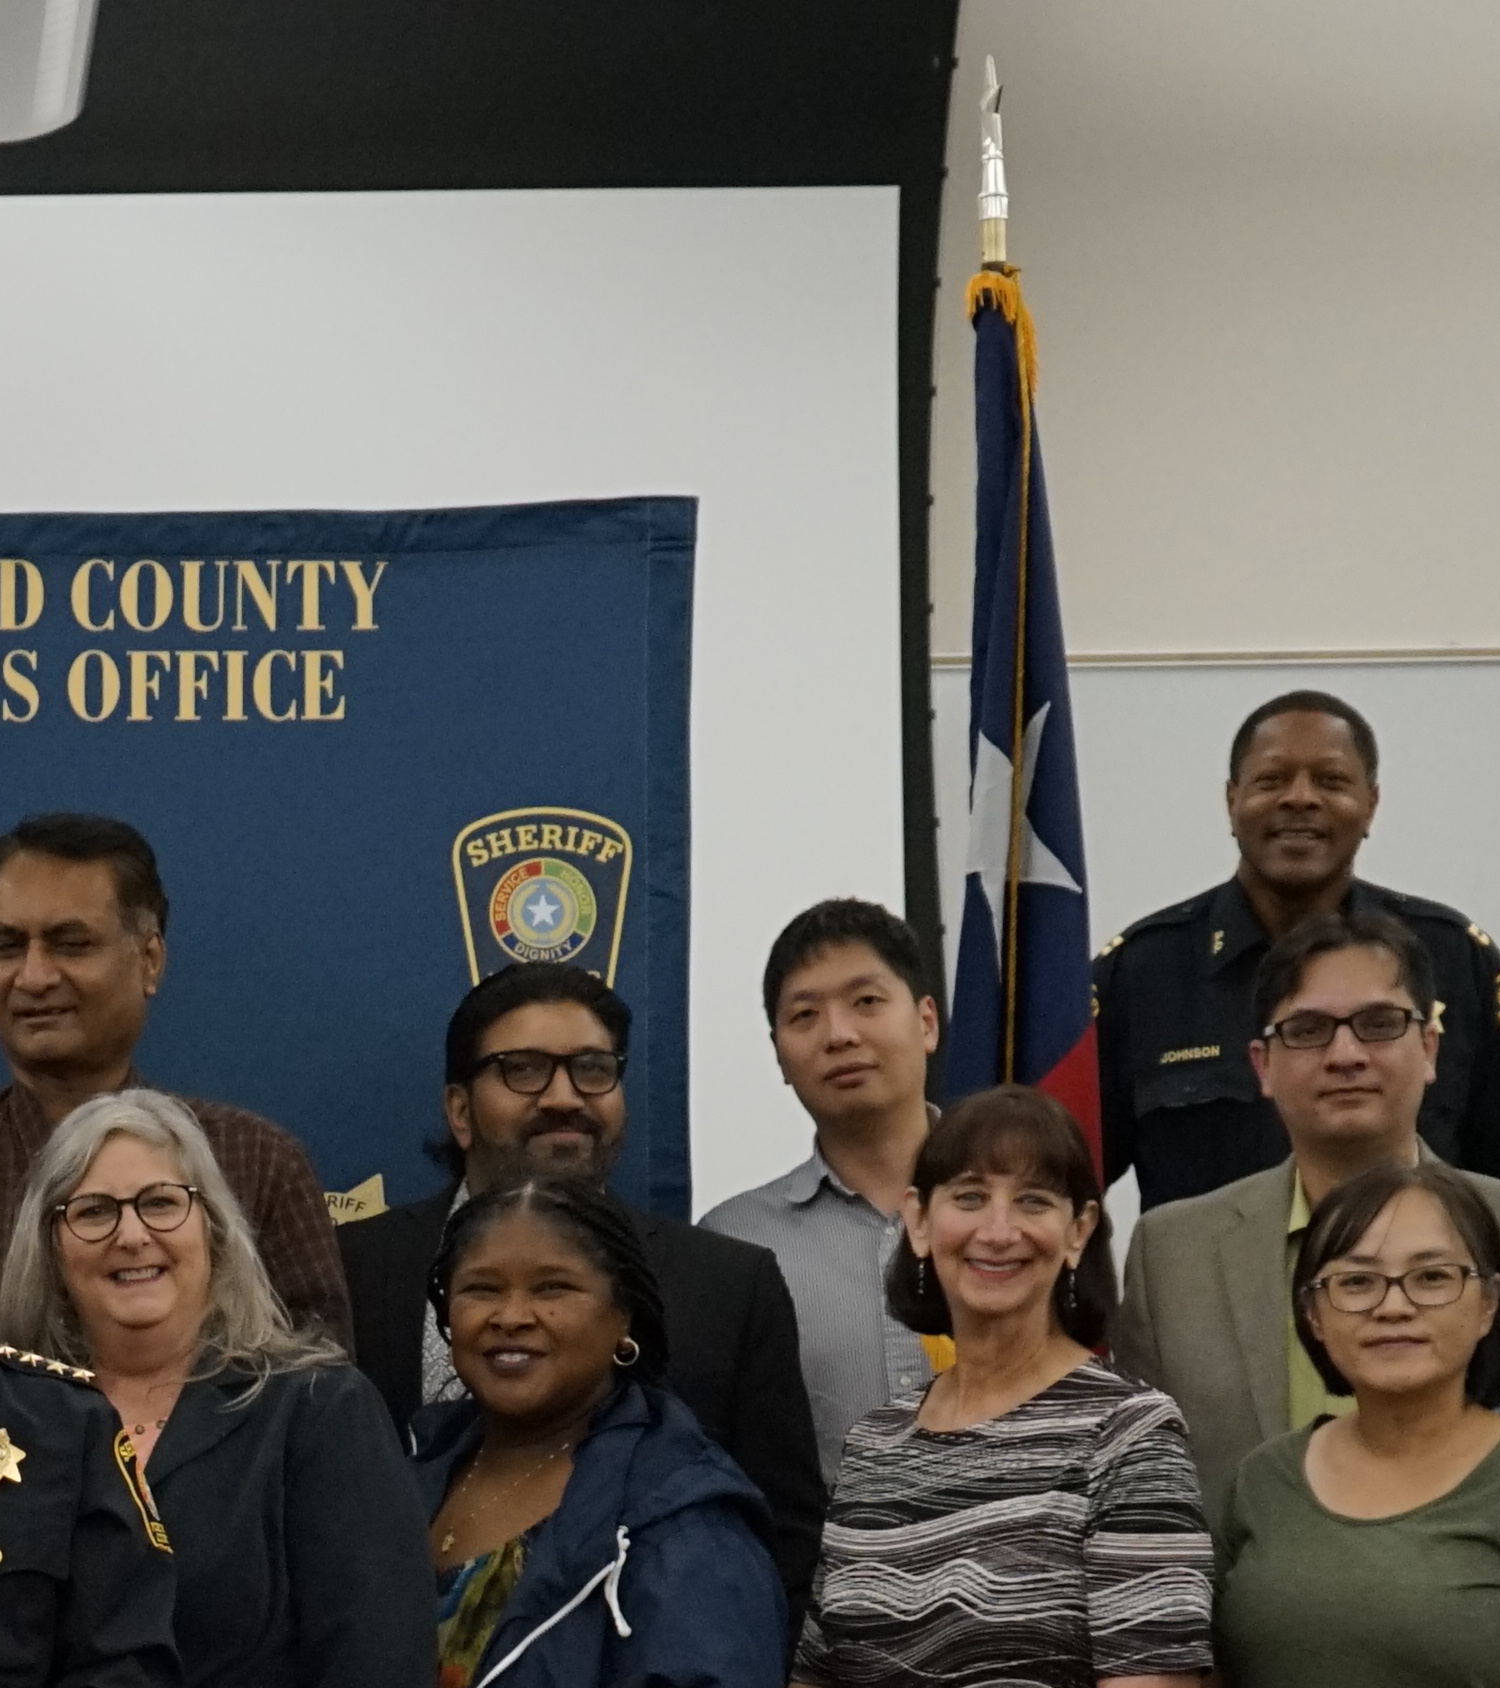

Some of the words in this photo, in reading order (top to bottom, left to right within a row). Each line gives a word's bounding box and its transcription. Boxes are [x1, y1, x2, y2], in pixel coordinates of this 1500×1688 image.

[71, 558, 389, 632] COUNTY
[67, 648, 346, 723] OFFICE
[466, 823, 623, 867] SHERIFF
[494, 867, 529, 922] SERVICE
[559, 870, 591, 914] HONOR
[514, 939, 573, 961] DIGNITY
[1160, 1045, 1220, 1064] JOHNSON
[327, 1195, 367, 1213] RIFF
